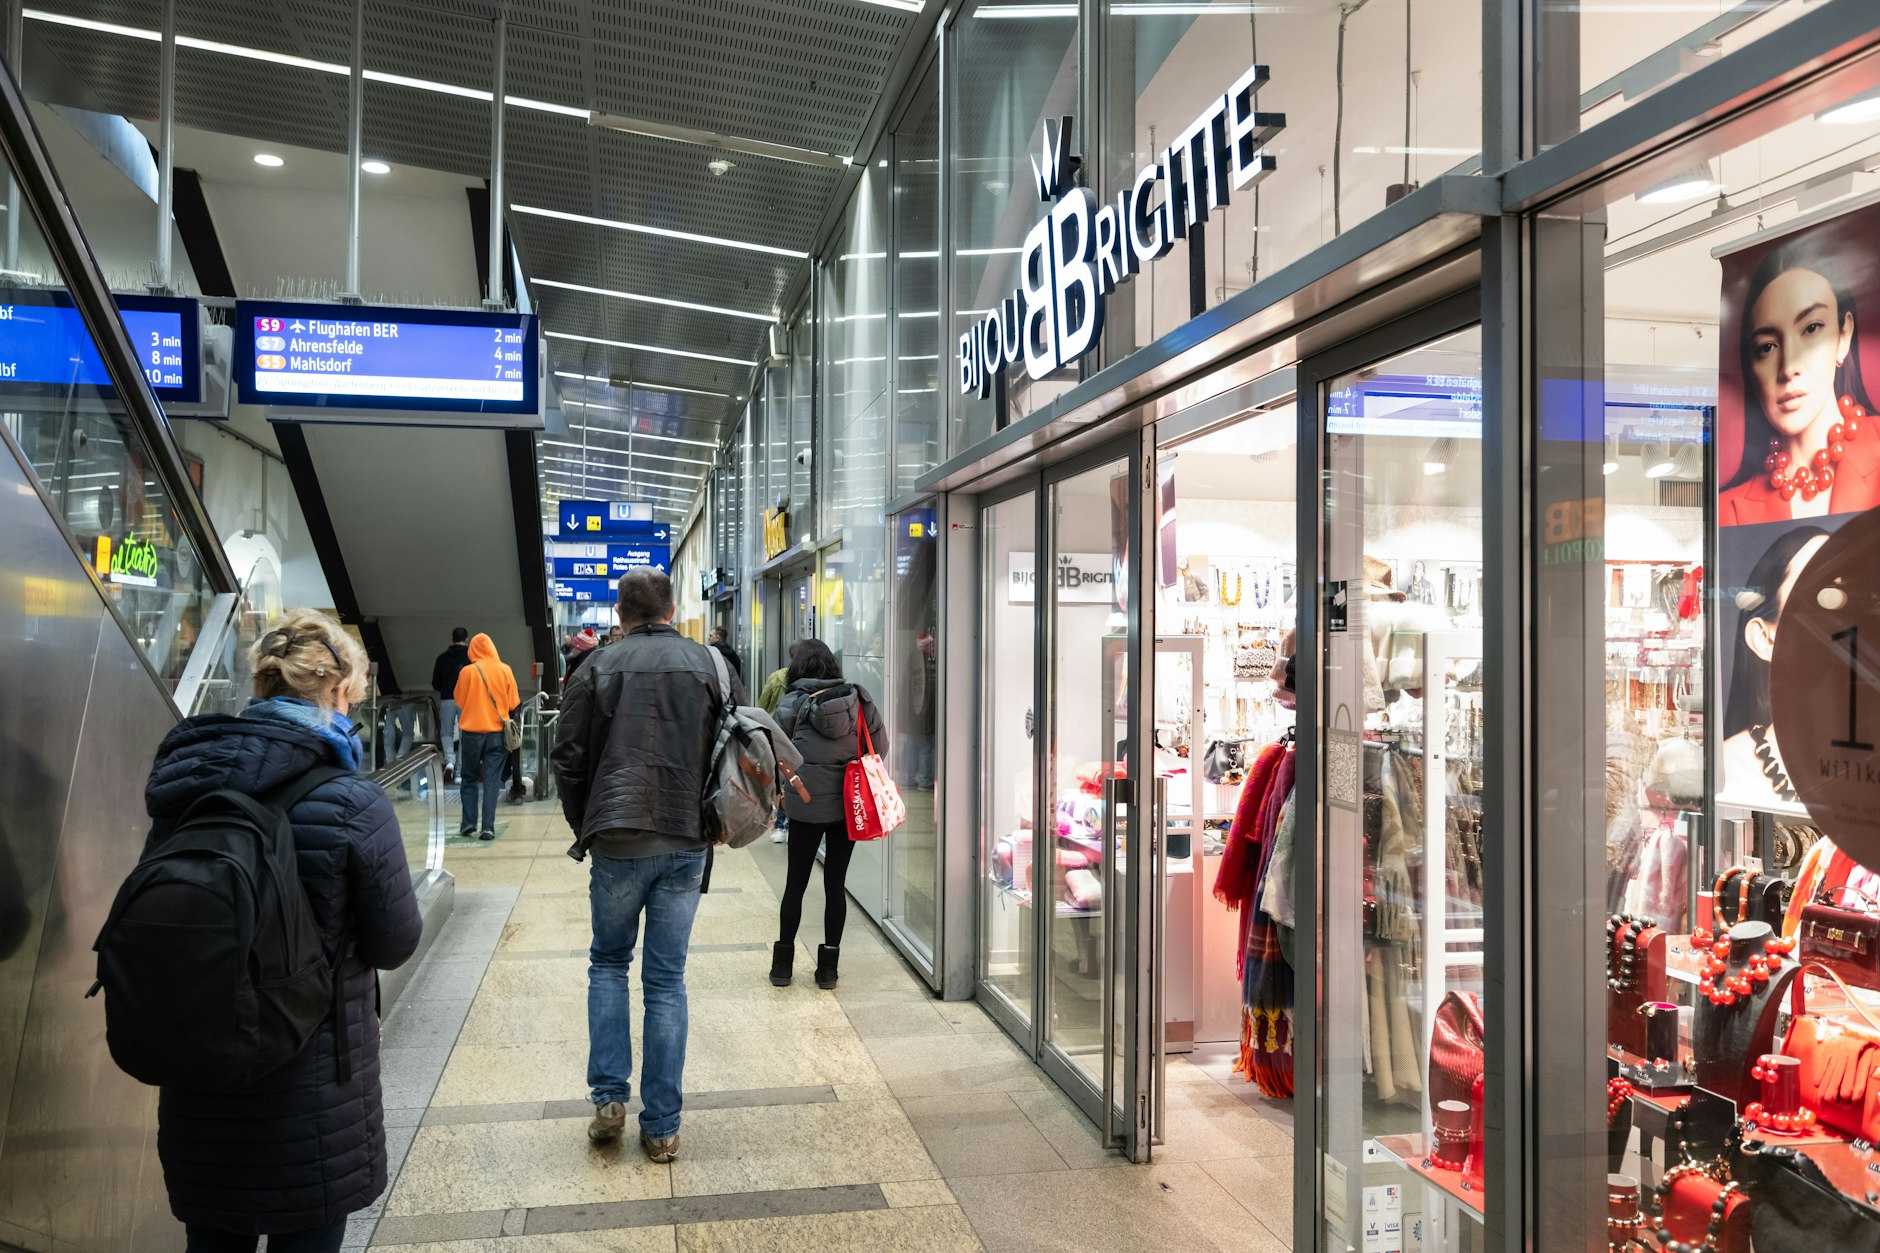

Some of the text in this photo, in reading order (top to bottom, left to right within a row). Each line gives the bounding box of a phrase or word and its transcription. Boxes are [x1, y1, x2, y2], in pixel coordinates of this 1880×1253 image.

[260, 318, 399, 339] S9 Flughafen BER
[494, 328, 521, 344] 2 min
[151, 331, 181, 348] 3 min
[261, 338, 363, 355] S7 Ahrensfelde
[959, 290, 1024, 400] BIJOU
[151, 350, 182, 366] 8 min
[494, 346, 521, 362] 4 min
[261, 355, 352, 372] S5 Mahlsdorf
[164, 372, 182, 385] min
[494, 364, 521, 380] 7 min
[627, 550, 651, 559] Ausgang
